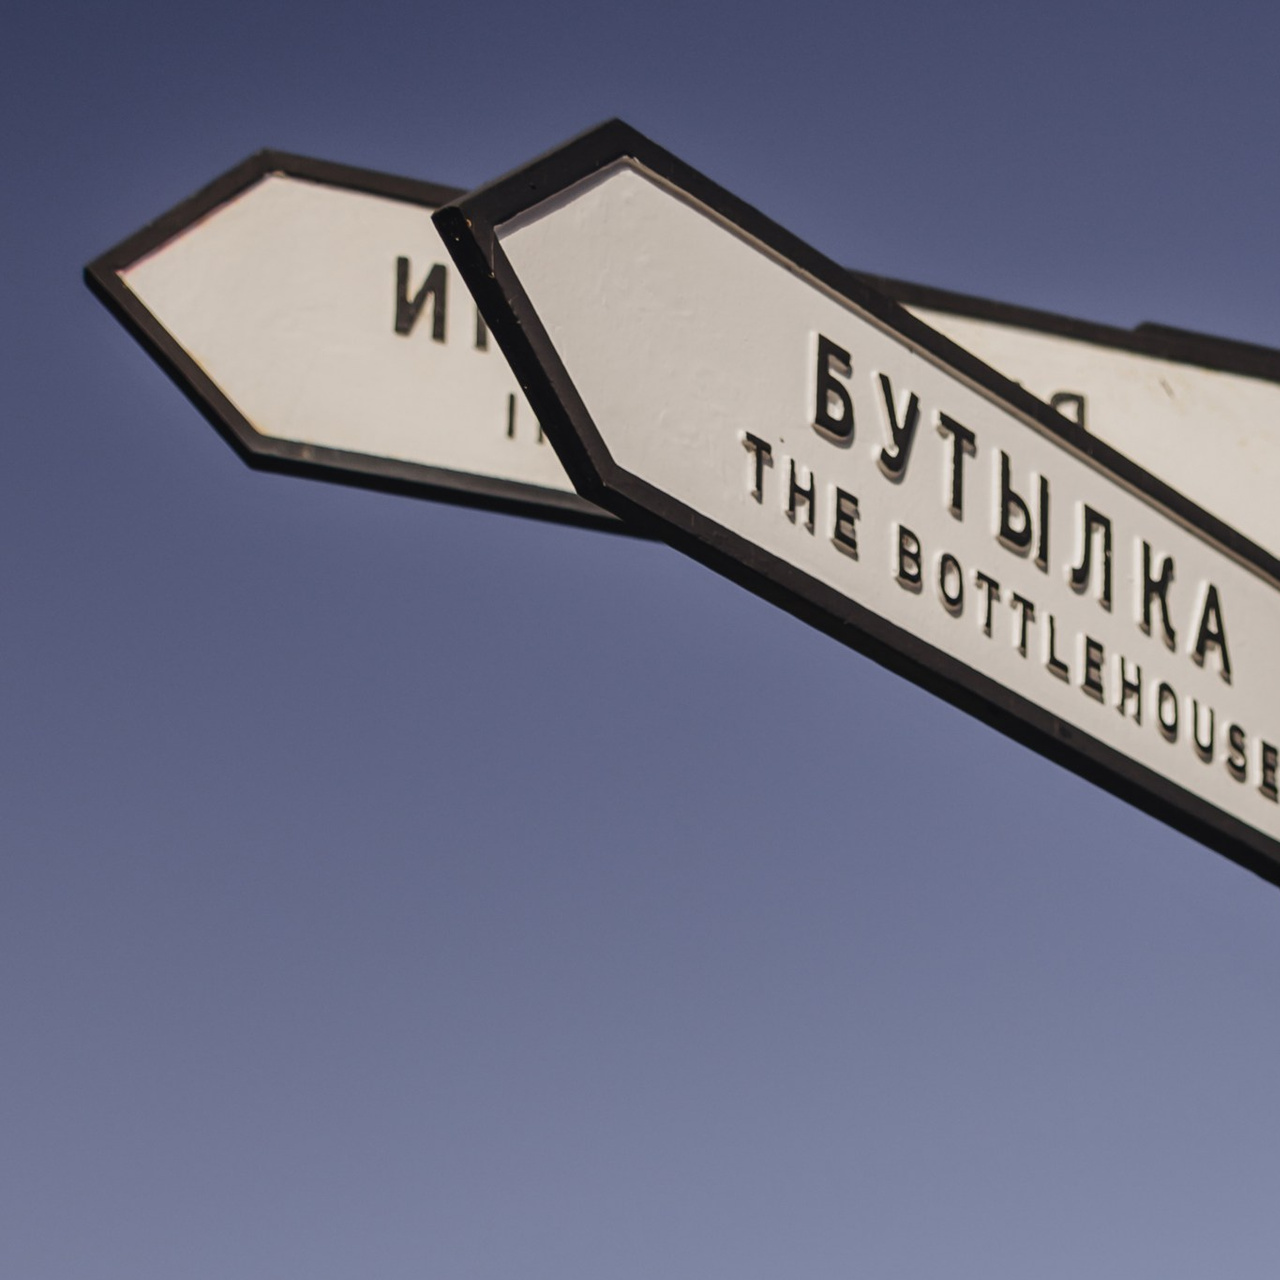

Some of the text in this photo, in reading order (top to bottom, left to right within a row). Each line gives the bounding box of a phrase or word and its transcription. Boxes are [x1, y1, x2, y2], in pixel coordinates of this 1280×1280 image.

[740, 431, 1280, 803] THE BOTTLEHOUSE
[810, 332, 1232, 684] БУТЫЛКА
